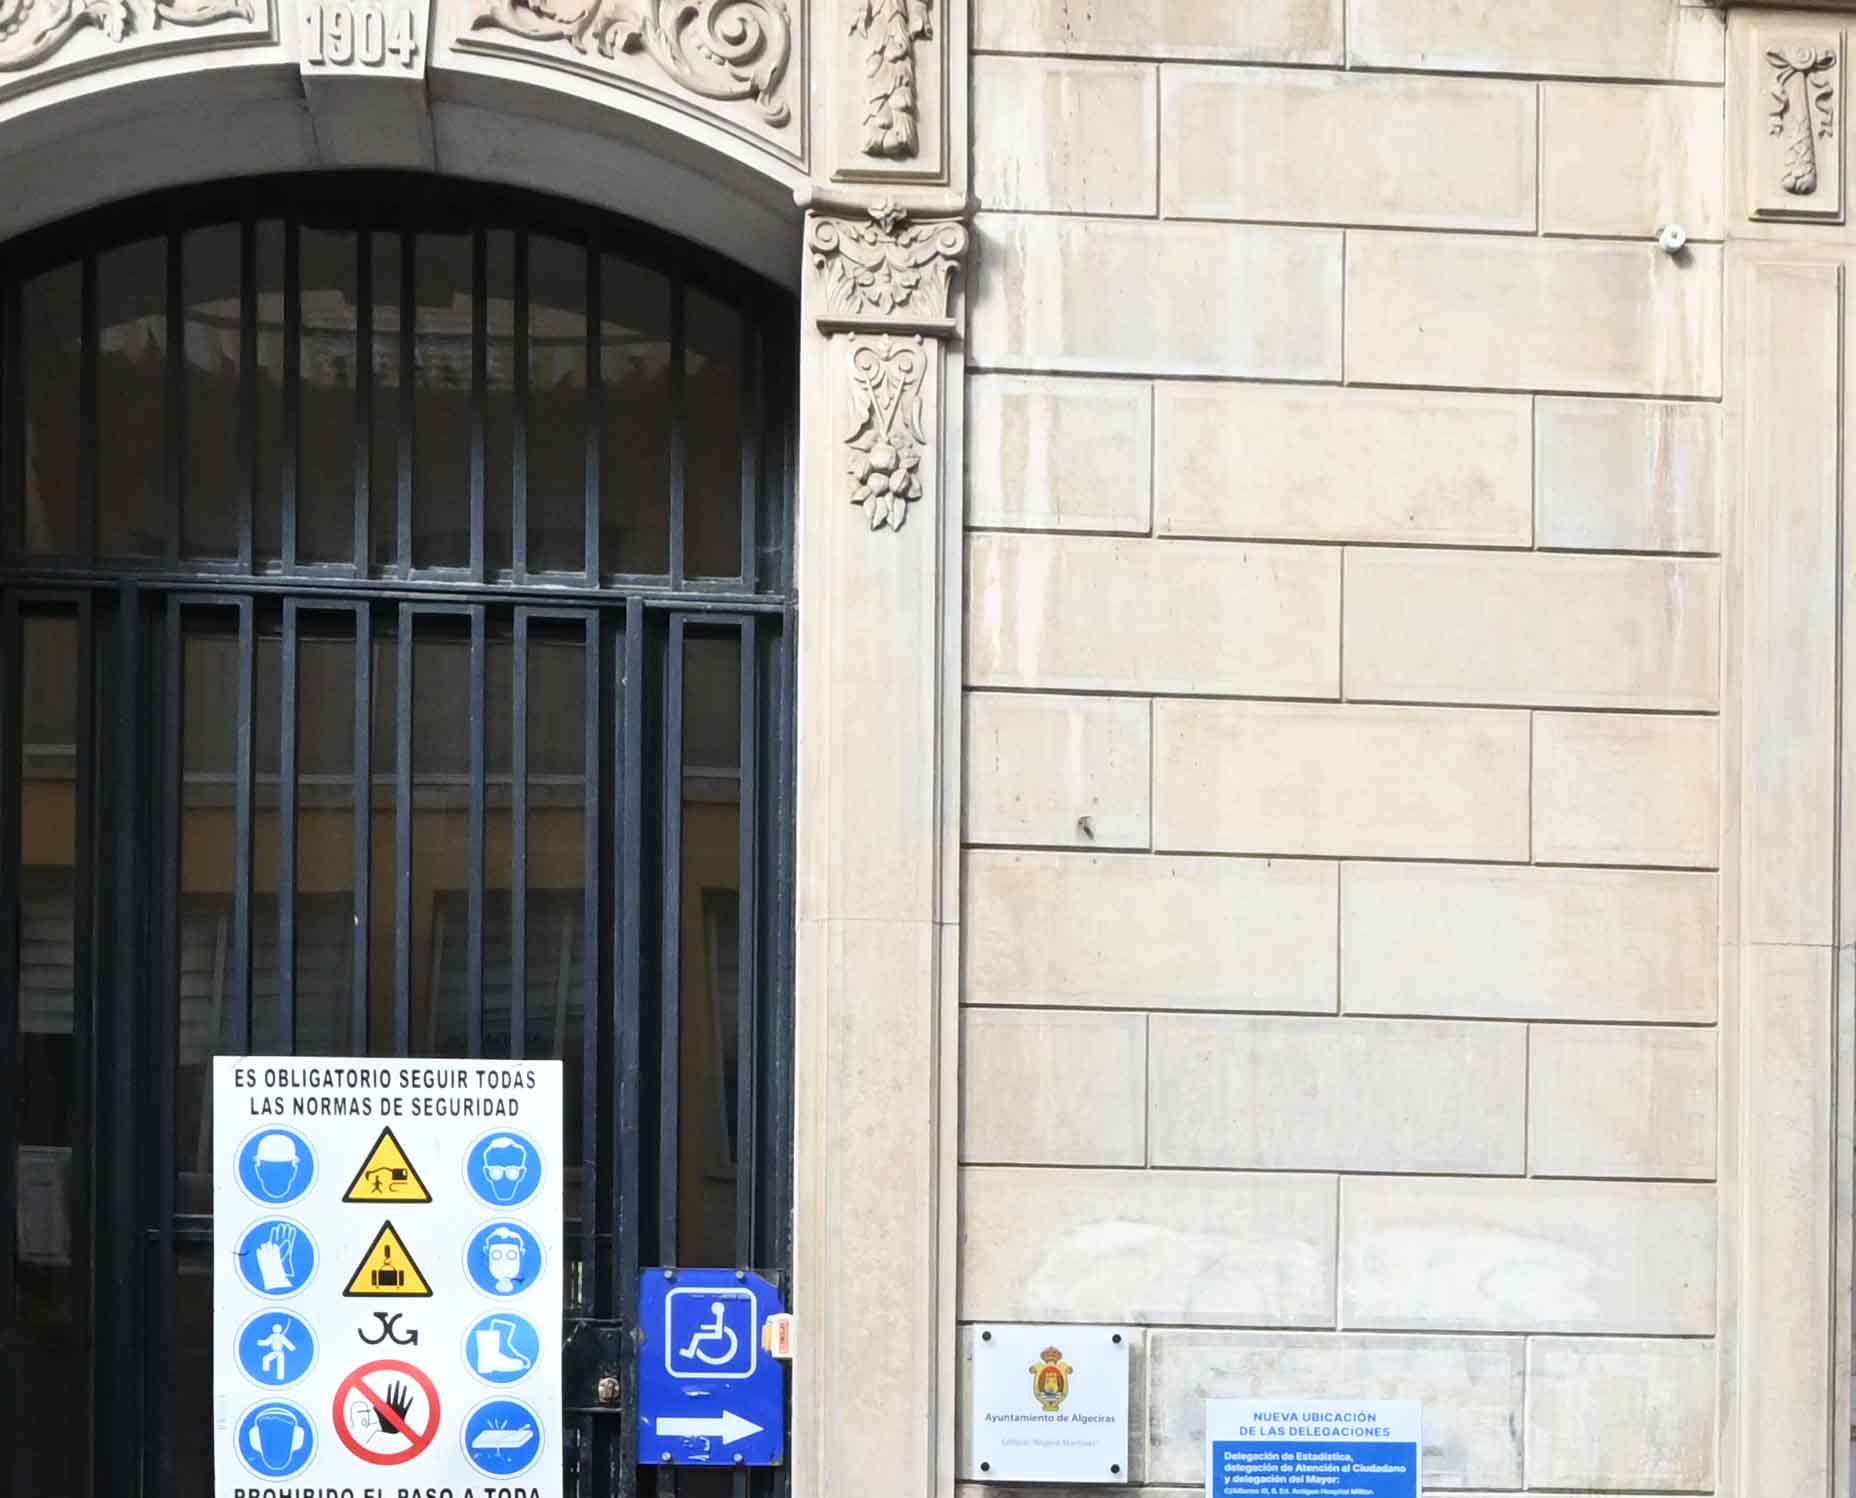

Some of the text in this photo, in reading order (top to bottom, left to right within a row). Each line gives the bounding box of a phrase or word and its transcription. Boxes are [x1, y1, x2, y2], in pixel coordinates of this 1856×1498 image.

[305, 6, 419, 69] 1904
[235, 1068, 536, 1089] ES OBLIGATORIO SEGUIR TODAS
[250, 1097, 519, 1116] LAS NORMAS DE SEGURIDAD
[985, 1412, 1116, 1424] Ayuntamiento de Algeciras
[1254, 1409, 1376, 1422] NUEVA UBICACIÓN
[1240, 1426, 1391, 1437] DE LAS DELEGACIONES
[1224, 1452, 1280, 1463] Delegación
[1282, 1452, 1294, 1461] de
[1224, 1463, 1406, 1475] delegación de Atención al Ciudadano
[1224, 1476, 1230, 1485] y
[1232, 1475, 1286, 1486] delegación
[1288, 1475, 1304, 1483] del
